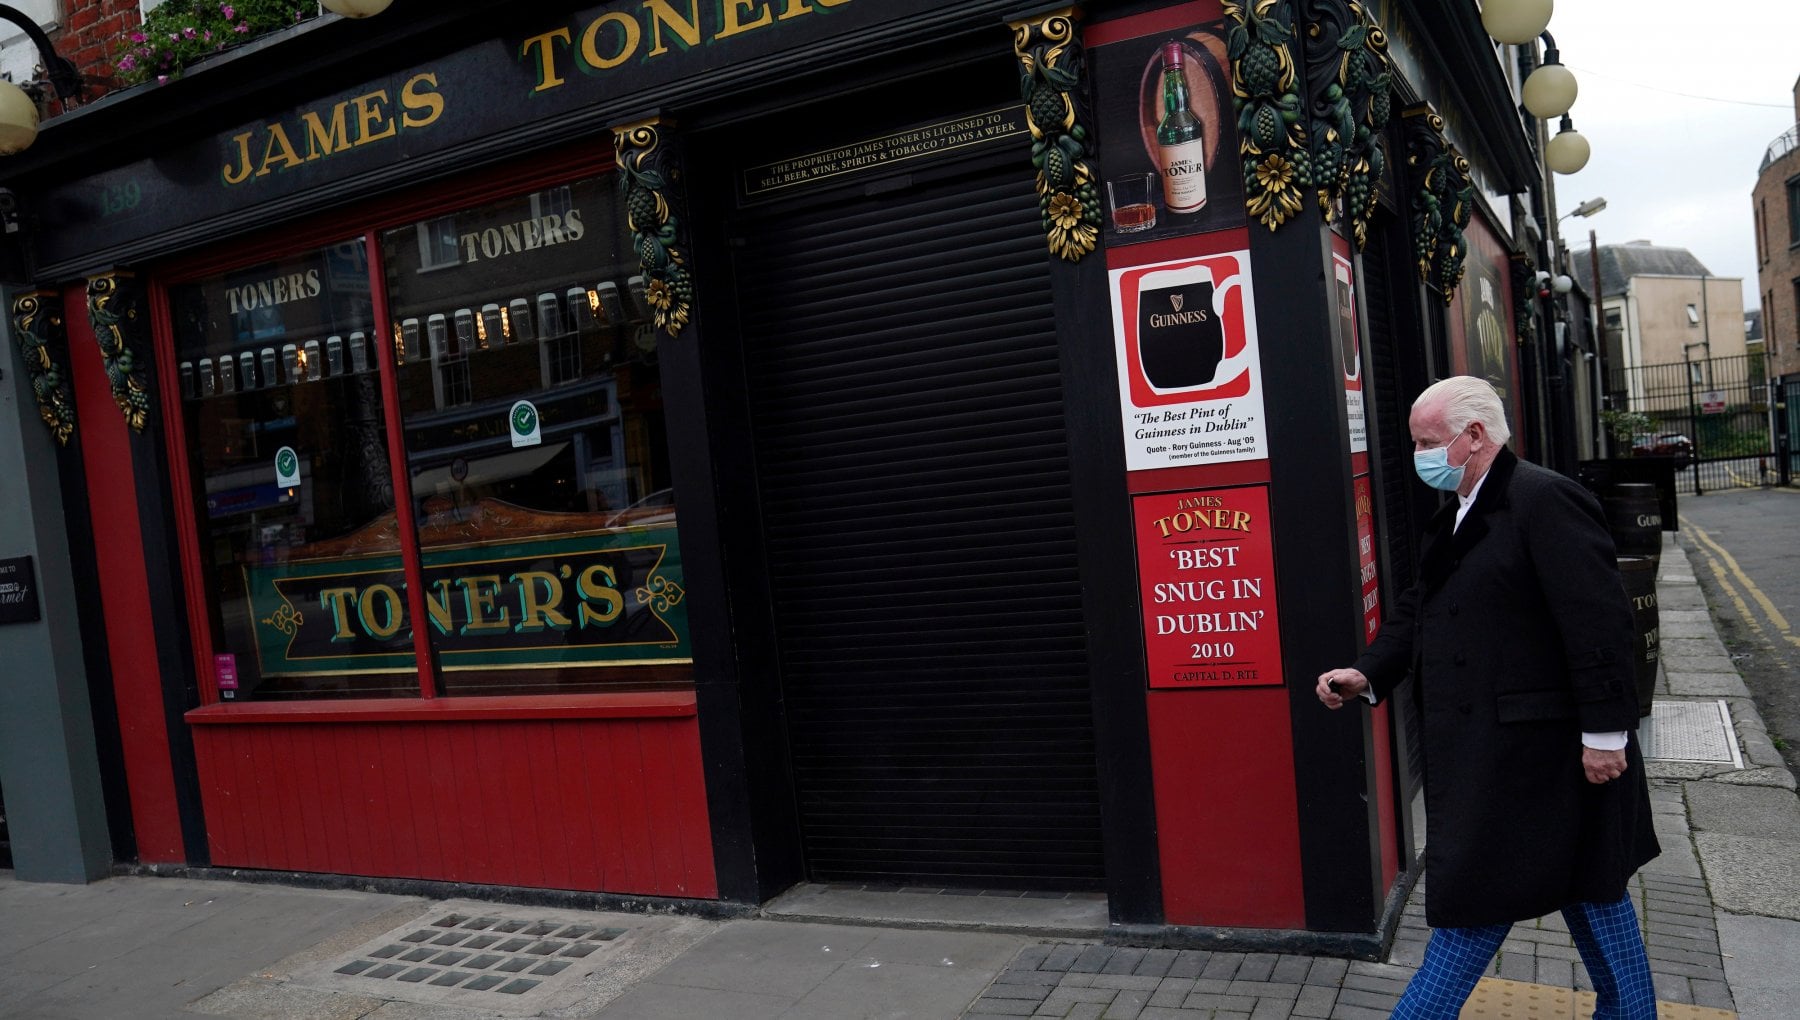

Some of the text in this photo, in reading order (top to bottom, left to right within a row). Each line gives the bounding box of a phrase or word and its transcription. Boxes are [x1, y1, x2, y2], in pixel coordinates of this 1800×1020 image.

[222, 72, 445, 186] JAMES
[761, 121, 1016, 188] SELL BEER, WINE, SPIRITS & TOBACCO 7 DAYS A WEEK
[770, 114, 1001, 175] THE PROPRIETOR JAMES TONER IS LICENSED TO
[1163, 163, 1202, 177] TONER
[100, 181, 141, 217] 139
[461, 209, 585, 264] TONERS
[225, 268, 321, 316] TONERS
[1149, 309, 1207, 328] GUINNESS
[1163, 411, 1187, 422] Best
[1190, 408, 1216, 420] Pint
[1218, 404, 1232, 419] of
[1135, 427, 1187, 440] Guinness
[1189, 424, 1202, 435] in
[1146, 445, 1167, 454] Quote
[1172, 443, 1188, 451] Rory
[1189, 440, 1222, 450] Guinness
[1227, 438, 1241, 447] Aug
[1242, 436, 1255, 445] '09
[1168, 453, 1193, 461] (member
[1210, 448, 1235, 456] Guinness
[1236, 446, 1256, 455] family)
[1177, 496, 1223, 510] JAMES
[1153, 508, 1251, 539] TONER
[1170, 546, 1240, 571] 'BEST
[320, 563, 625, 643] TONER'S
[1154, 578, 1262, 604] SNUG IN
[1156, 610, 1265, 635] DUBLIN'
[1190, 642, 1234, 659] 2010
[1173, 671, 1220, 682] CAPITAL
